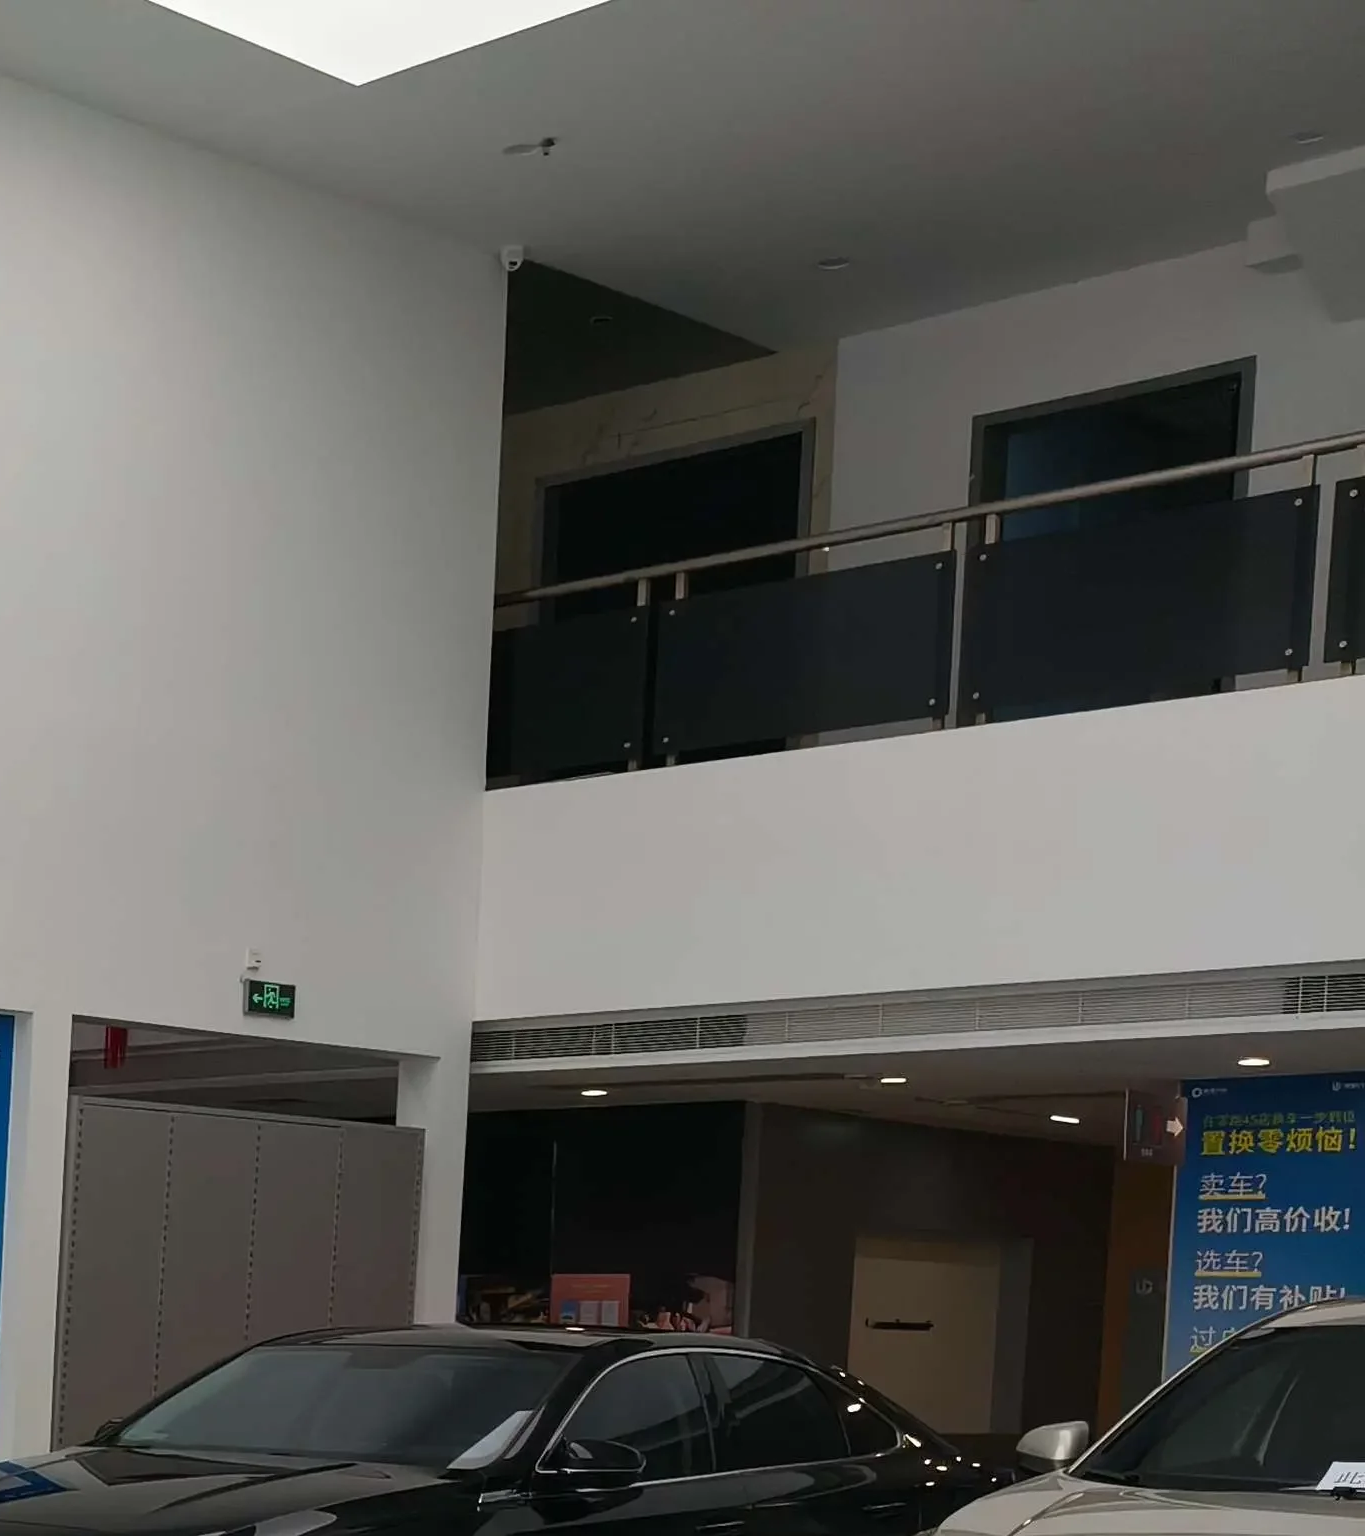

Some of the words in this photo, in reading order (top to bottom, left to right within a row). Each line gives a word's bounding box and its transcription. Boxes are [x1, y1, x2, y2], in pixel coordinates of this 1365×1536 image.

[1197, 1206, 1350, 1233] 我们高价收！
